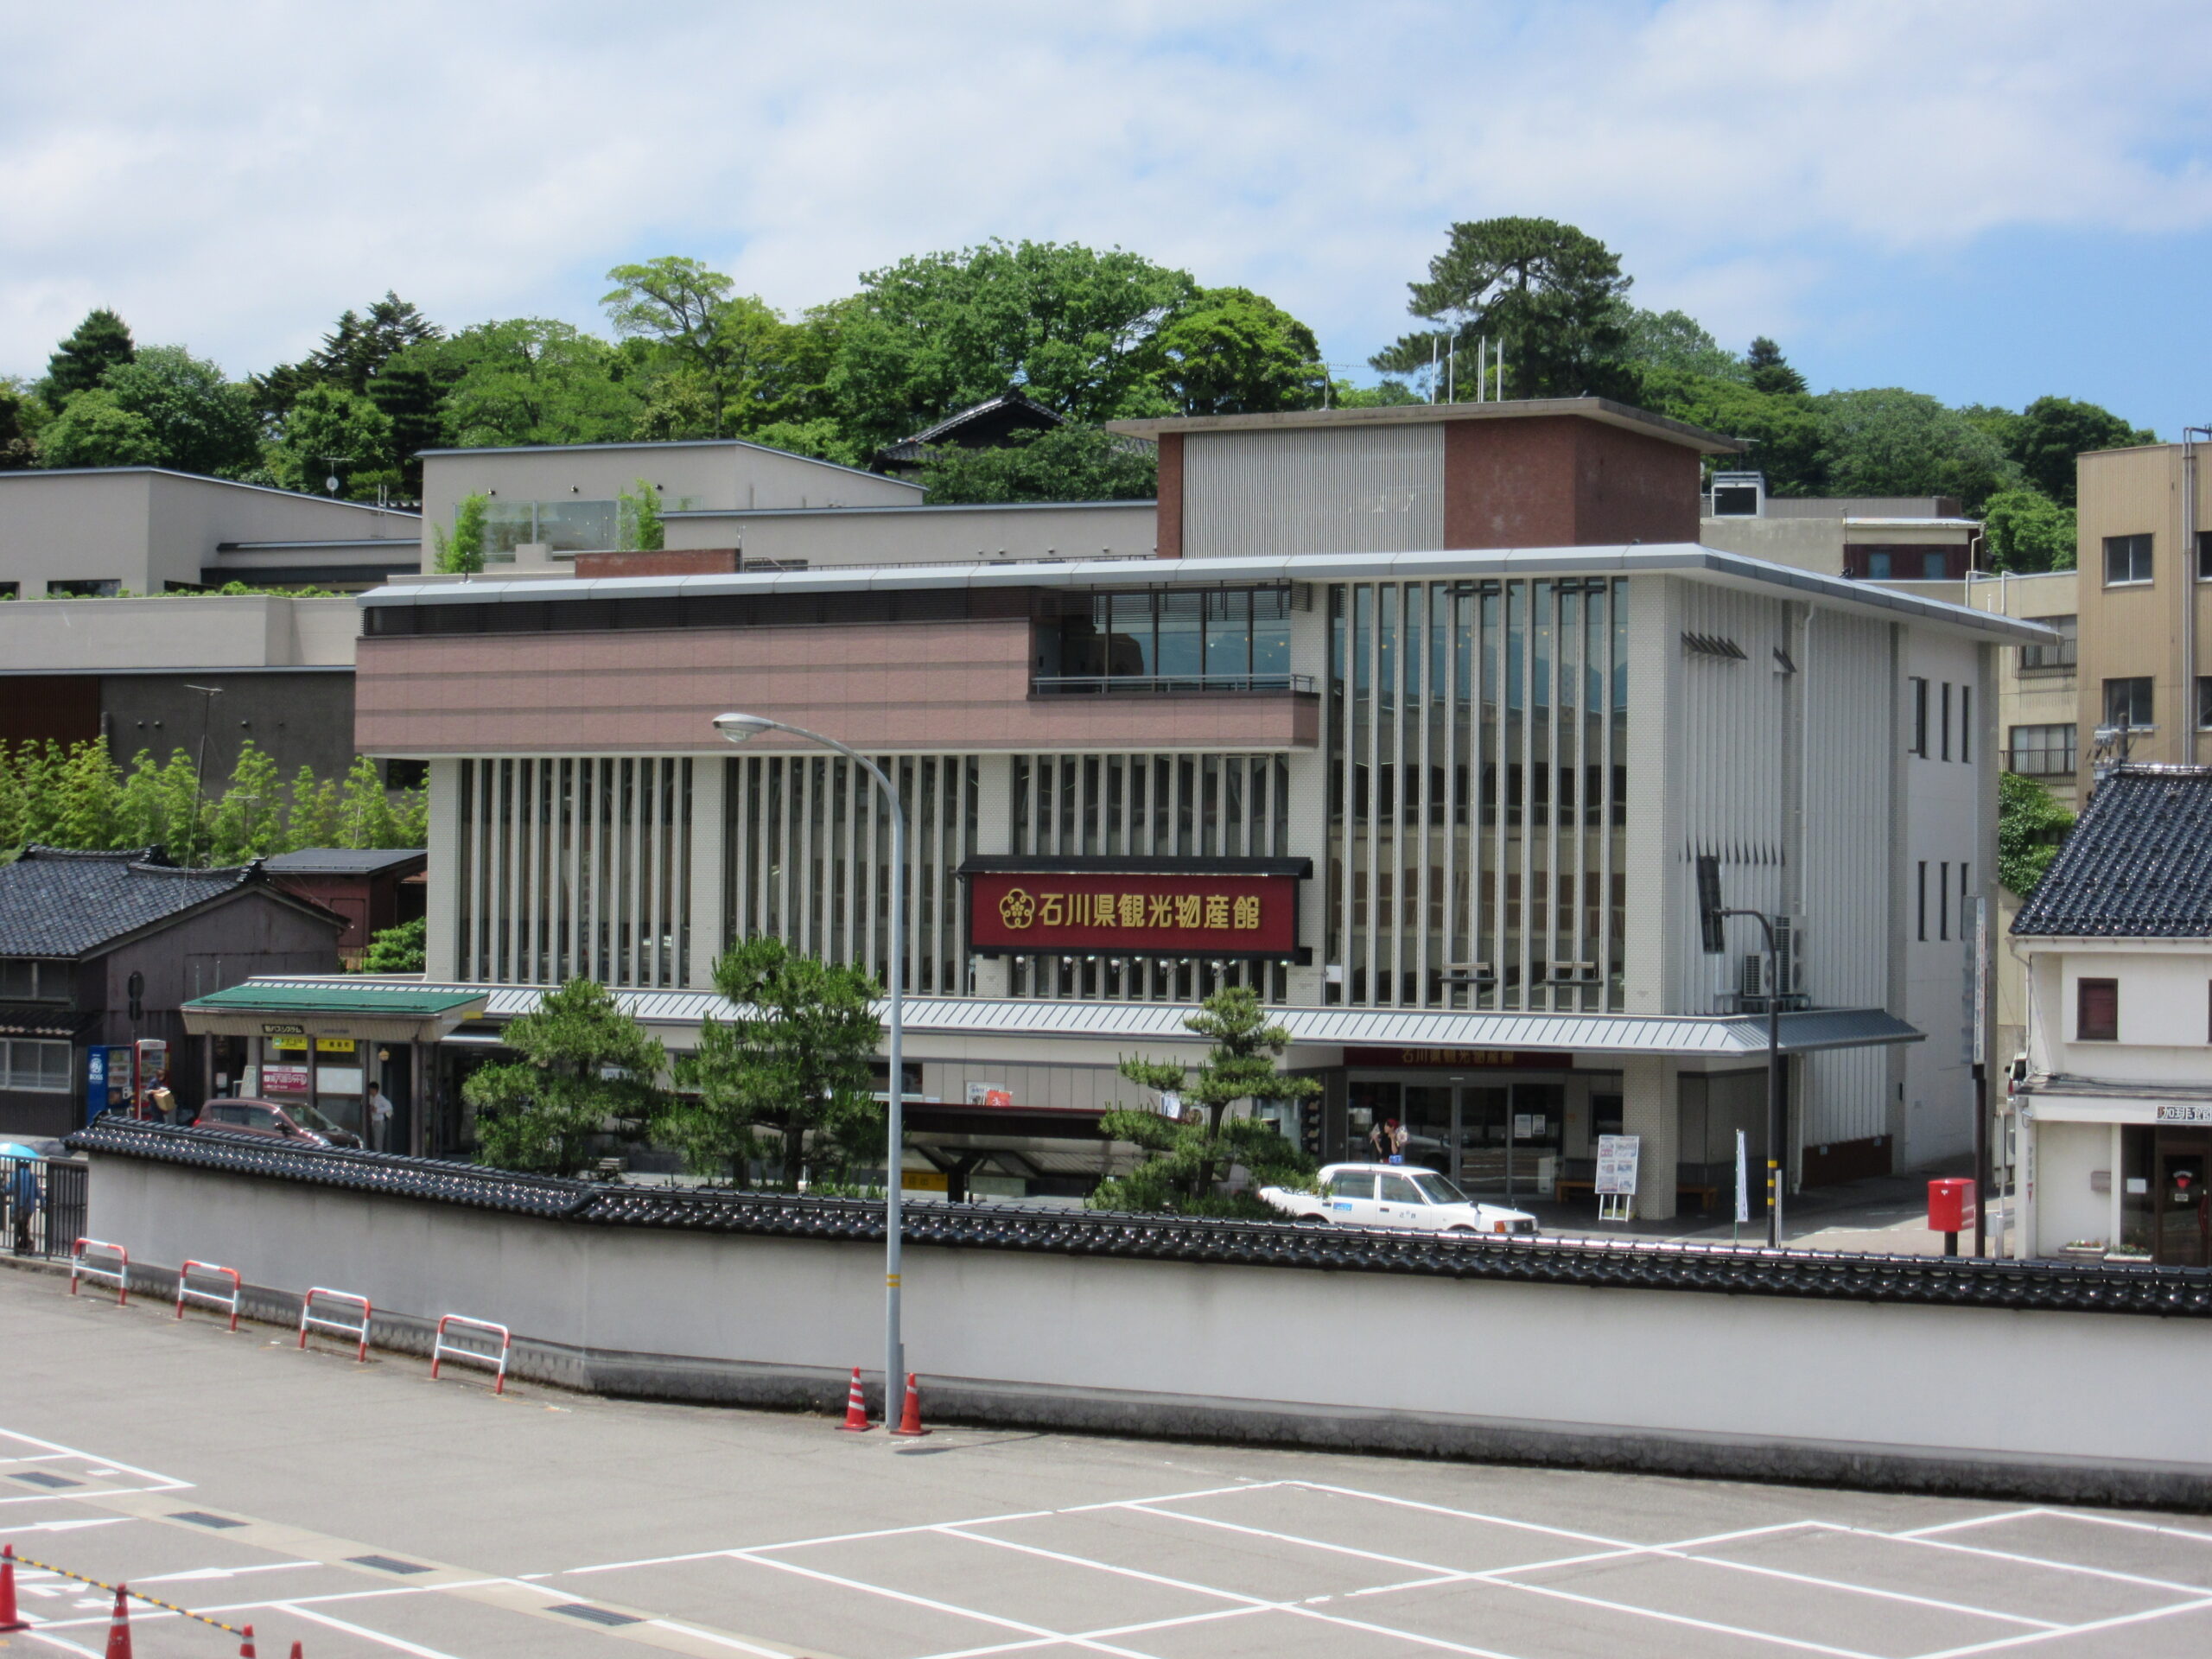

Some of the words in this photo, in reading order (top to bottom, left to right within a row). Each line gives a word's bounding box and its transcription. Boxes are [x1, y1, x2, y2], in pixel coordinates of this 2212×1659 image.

[1039, 893, 1261, 930] 石川県観光物産館
